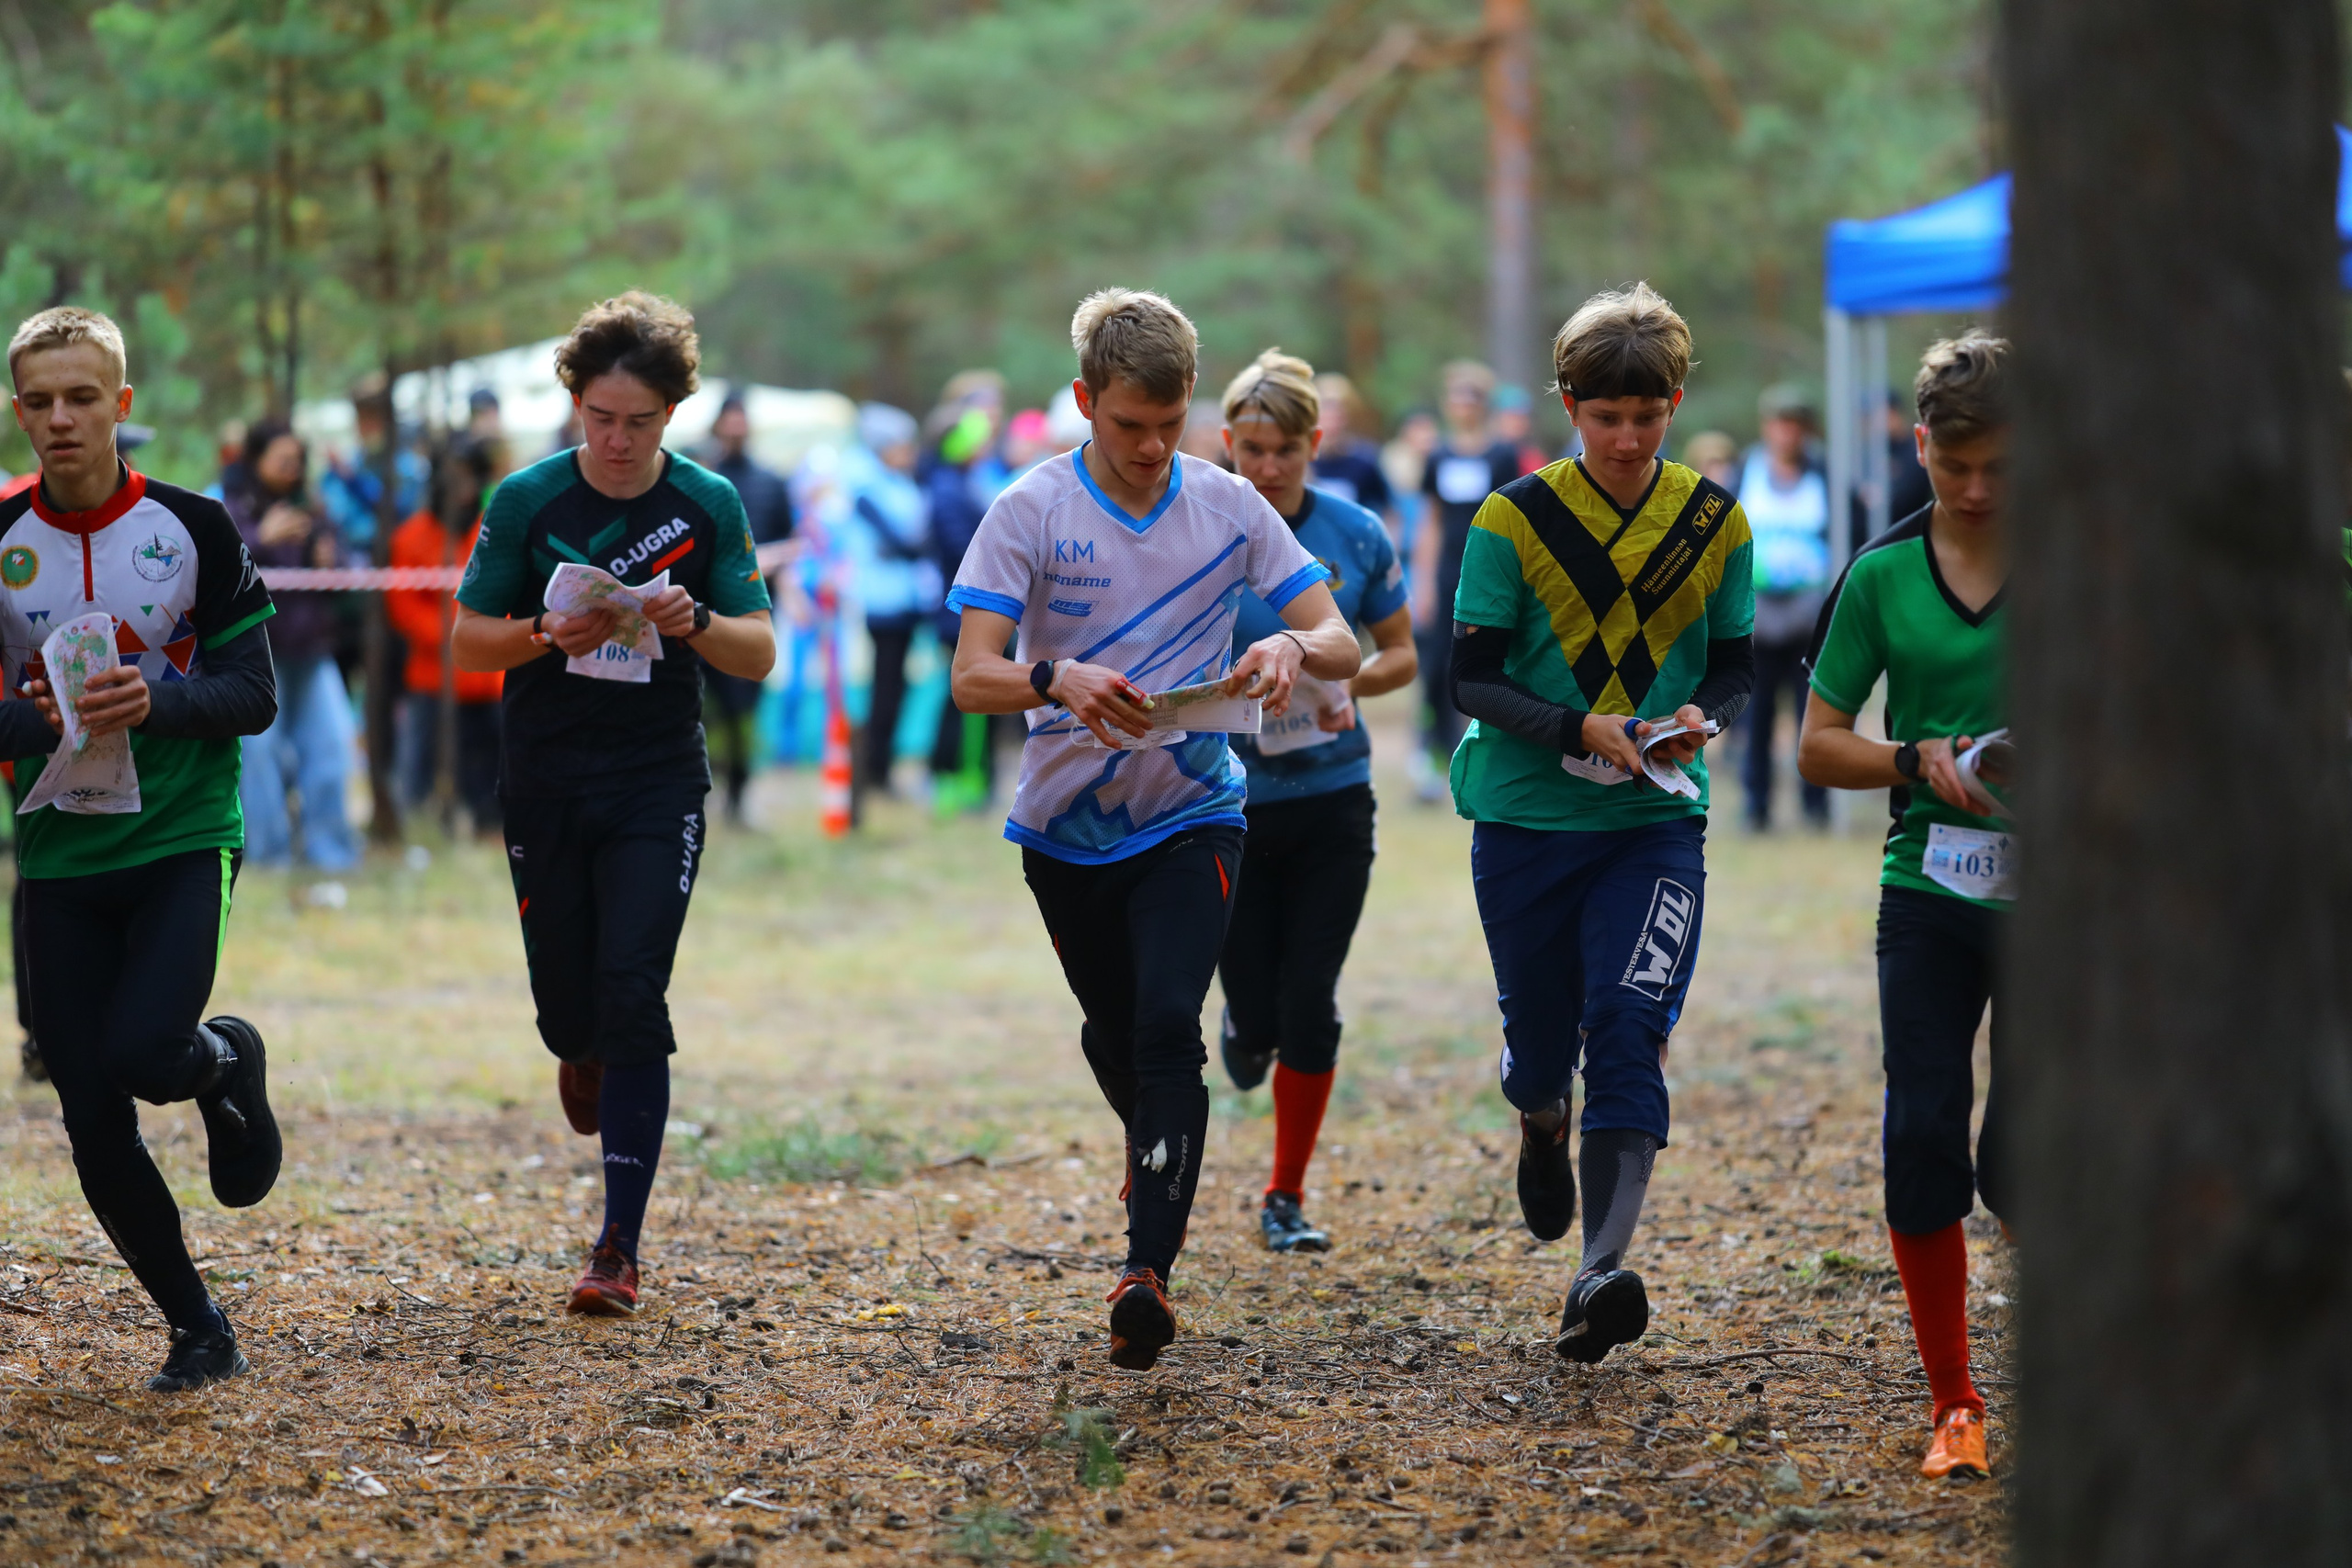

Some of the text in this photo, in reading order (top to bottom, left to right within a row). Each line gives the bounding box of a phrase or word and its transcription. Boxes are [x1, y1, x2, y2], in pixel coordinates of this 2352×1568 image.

[609, 516, 691, 578] O-UGRA
[1055, 539, 1094, 564] KM
[1641, 538, 1688, 592] Hämeenlinnan
[1651, 547, 1693, 595] Suunnistajat
[1043, 571, 1112, 588] noname
[595, 644, 631, 662] 108
[1279, 711, 1313, 735] 105
[1954, 852, 1995, 878] 103
